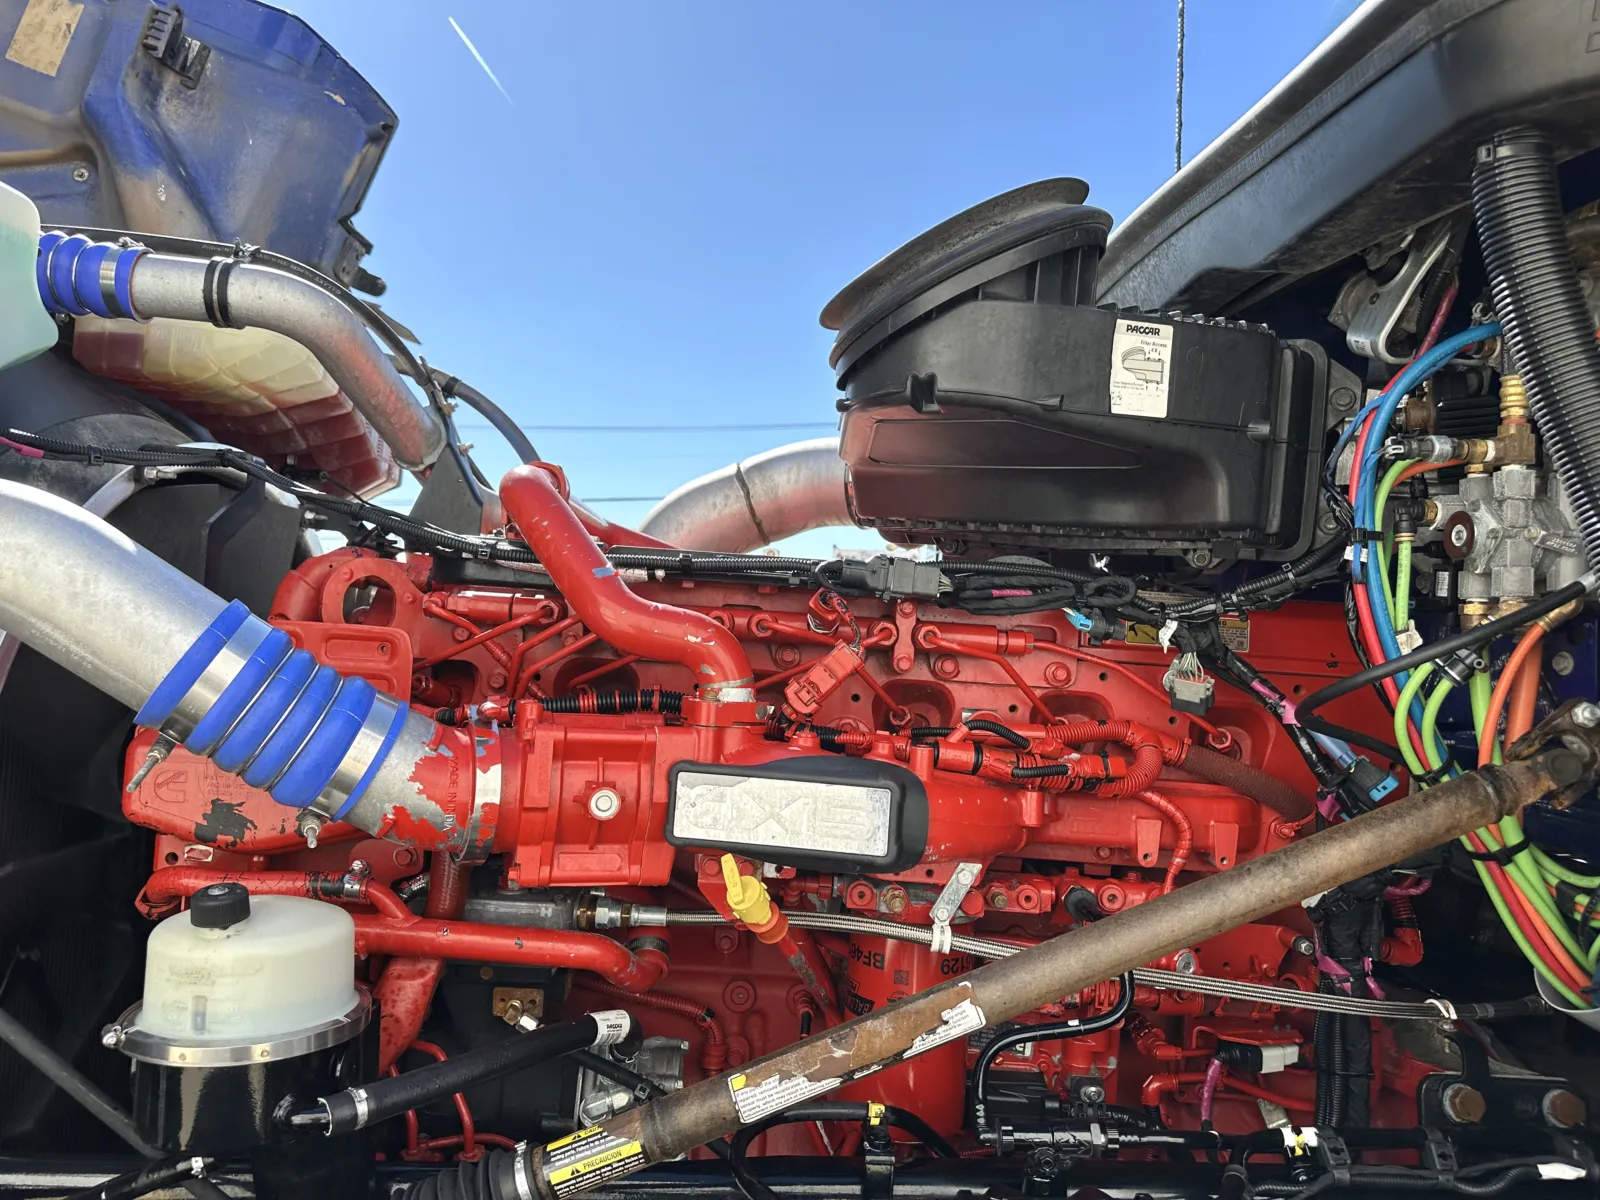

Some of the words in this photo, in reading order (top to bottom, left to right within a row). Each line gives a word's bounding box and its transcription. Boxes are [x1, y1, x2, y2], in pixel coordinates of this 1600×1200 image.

[1126, 324, 1160, 336] PACCAR
[446, 757, 458, 788] MADE
[446, 792, 456, 803] IN
[849, 943, 885, 970] BF46
